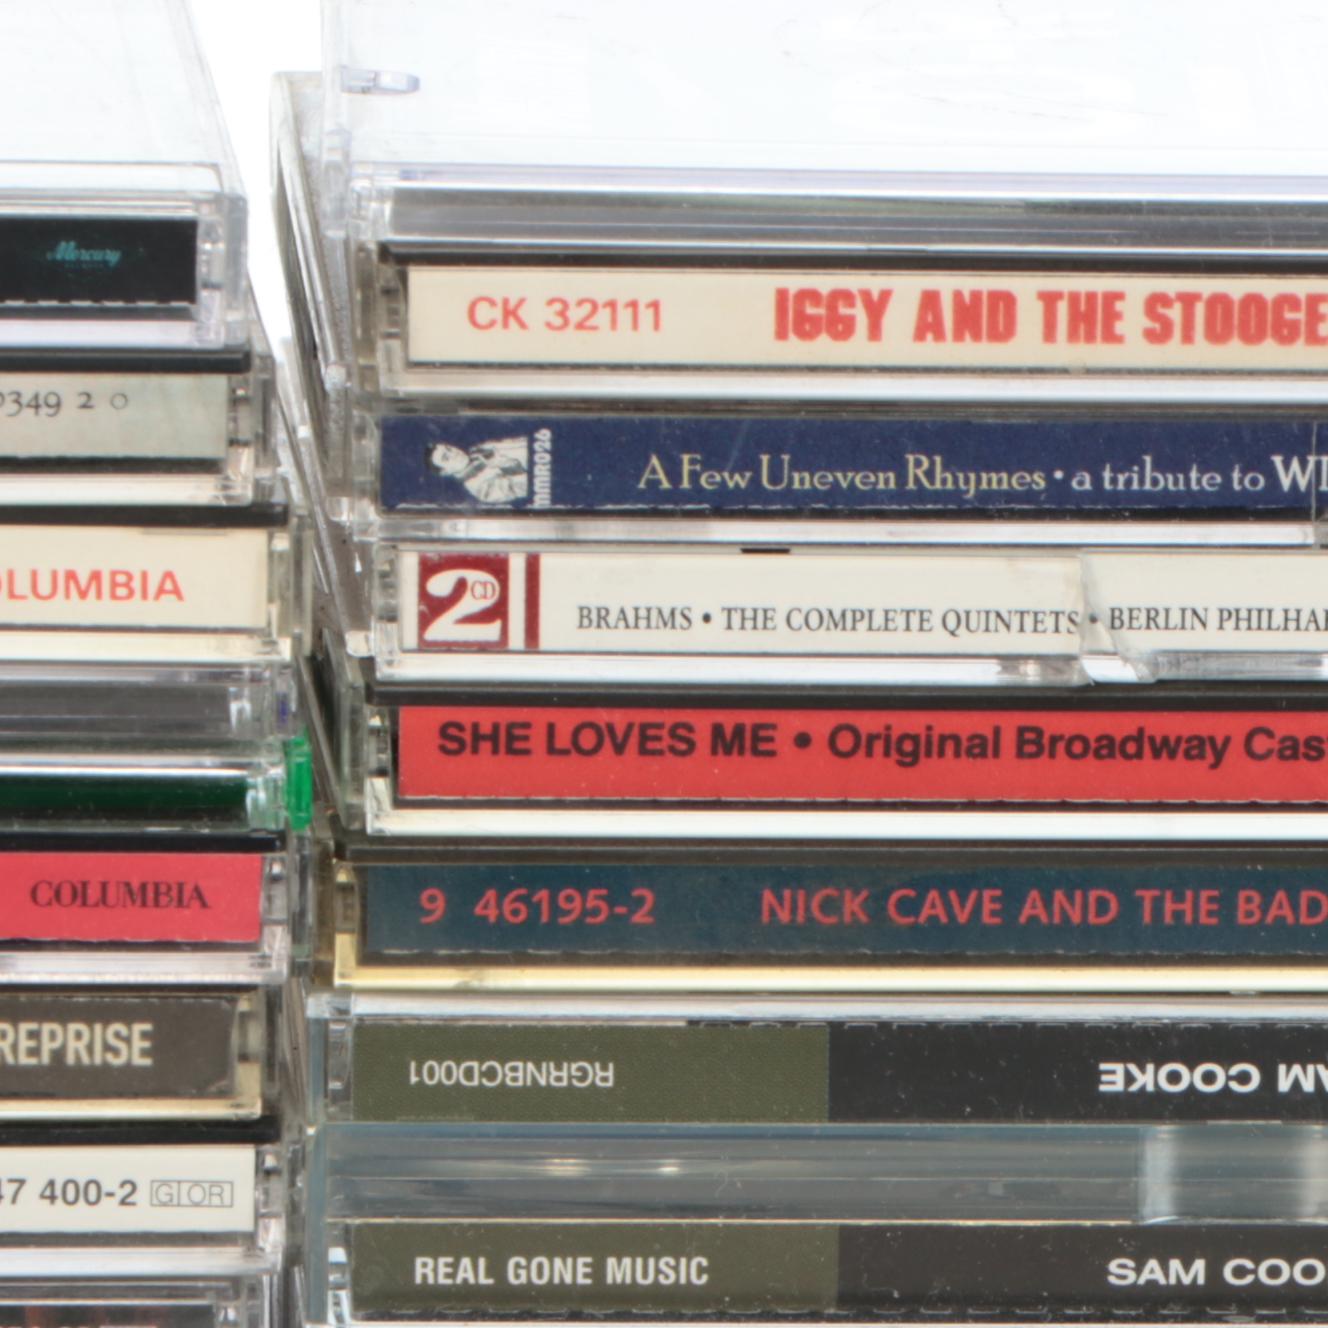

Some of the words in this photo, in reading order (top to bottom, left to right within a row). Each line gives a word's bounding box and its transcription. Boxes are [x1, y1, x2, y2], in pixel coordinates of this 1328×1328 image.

[468, 296, 528, 331] CK
[545, 297, 661, 332] 32111
[775, 288, 892, 342] IGGY
[913, 290, 1017, 343] AND
[1037, 291, 1125, 344] THE
[0, 390, 62, 417] 349
[78, 392, 95, 409] 2
[638, 454, 672, 490] A
[680, 453, 752, 490] Few
[760, 454, 897, 490] Uneven
[906, 454, 1046, 498] Rhymes
[1071, 472, 1092, 490] a
[1102, 455, 1222, 491] tribute
[1232, 464, 1265, 491] to
[0, 569, 184, 601] LUMBIA
[424, 570, 501, 642] 2
[471, 582, 496, 599] CD
[578, 606, 692, 630] BRAHMS
[721, 607, 776, 630] THE
[786, 608, 932, 632] COMPLETE
[942, 608, 1080, 637] QUINTETS
[1108, 607, 1207, 631] BERLIN
[439, 721, 532, 756] SHE
[547, 721, 697, 757] LOVES
[711, 723, 777, 757] ME
[828, 723, 1001, 767] Original
[1016, 725, 1231, 769] Broadway
[30, 880, 208, 909] COLUMBIA
[420, 887, 446, 924] 9
[474, 888, 655, 924] 46195-2
[762, 888, 869, 925] NICK
[887, 888, 1002, 925] CAVE
[1019, 889, 1119, 925] AND
[1136, 889, 1220, 925] THE
[0, 1022, 153, 1066] REPRISE
[410, 1060, 614, 1088] RGRNBCD001
[1099, 1062, 1260, 1093] COOKE
[0, 1178, 26, 1205] 7
[40, 1179, 137, 1206] 400-2
[415, 1257, 494, 1284] REAL
[507, 1256, 592, 1285] GONE
[606, 1256, 708, 1285] MUSIC
[1107, 1258, 1205, 1285] SAM
